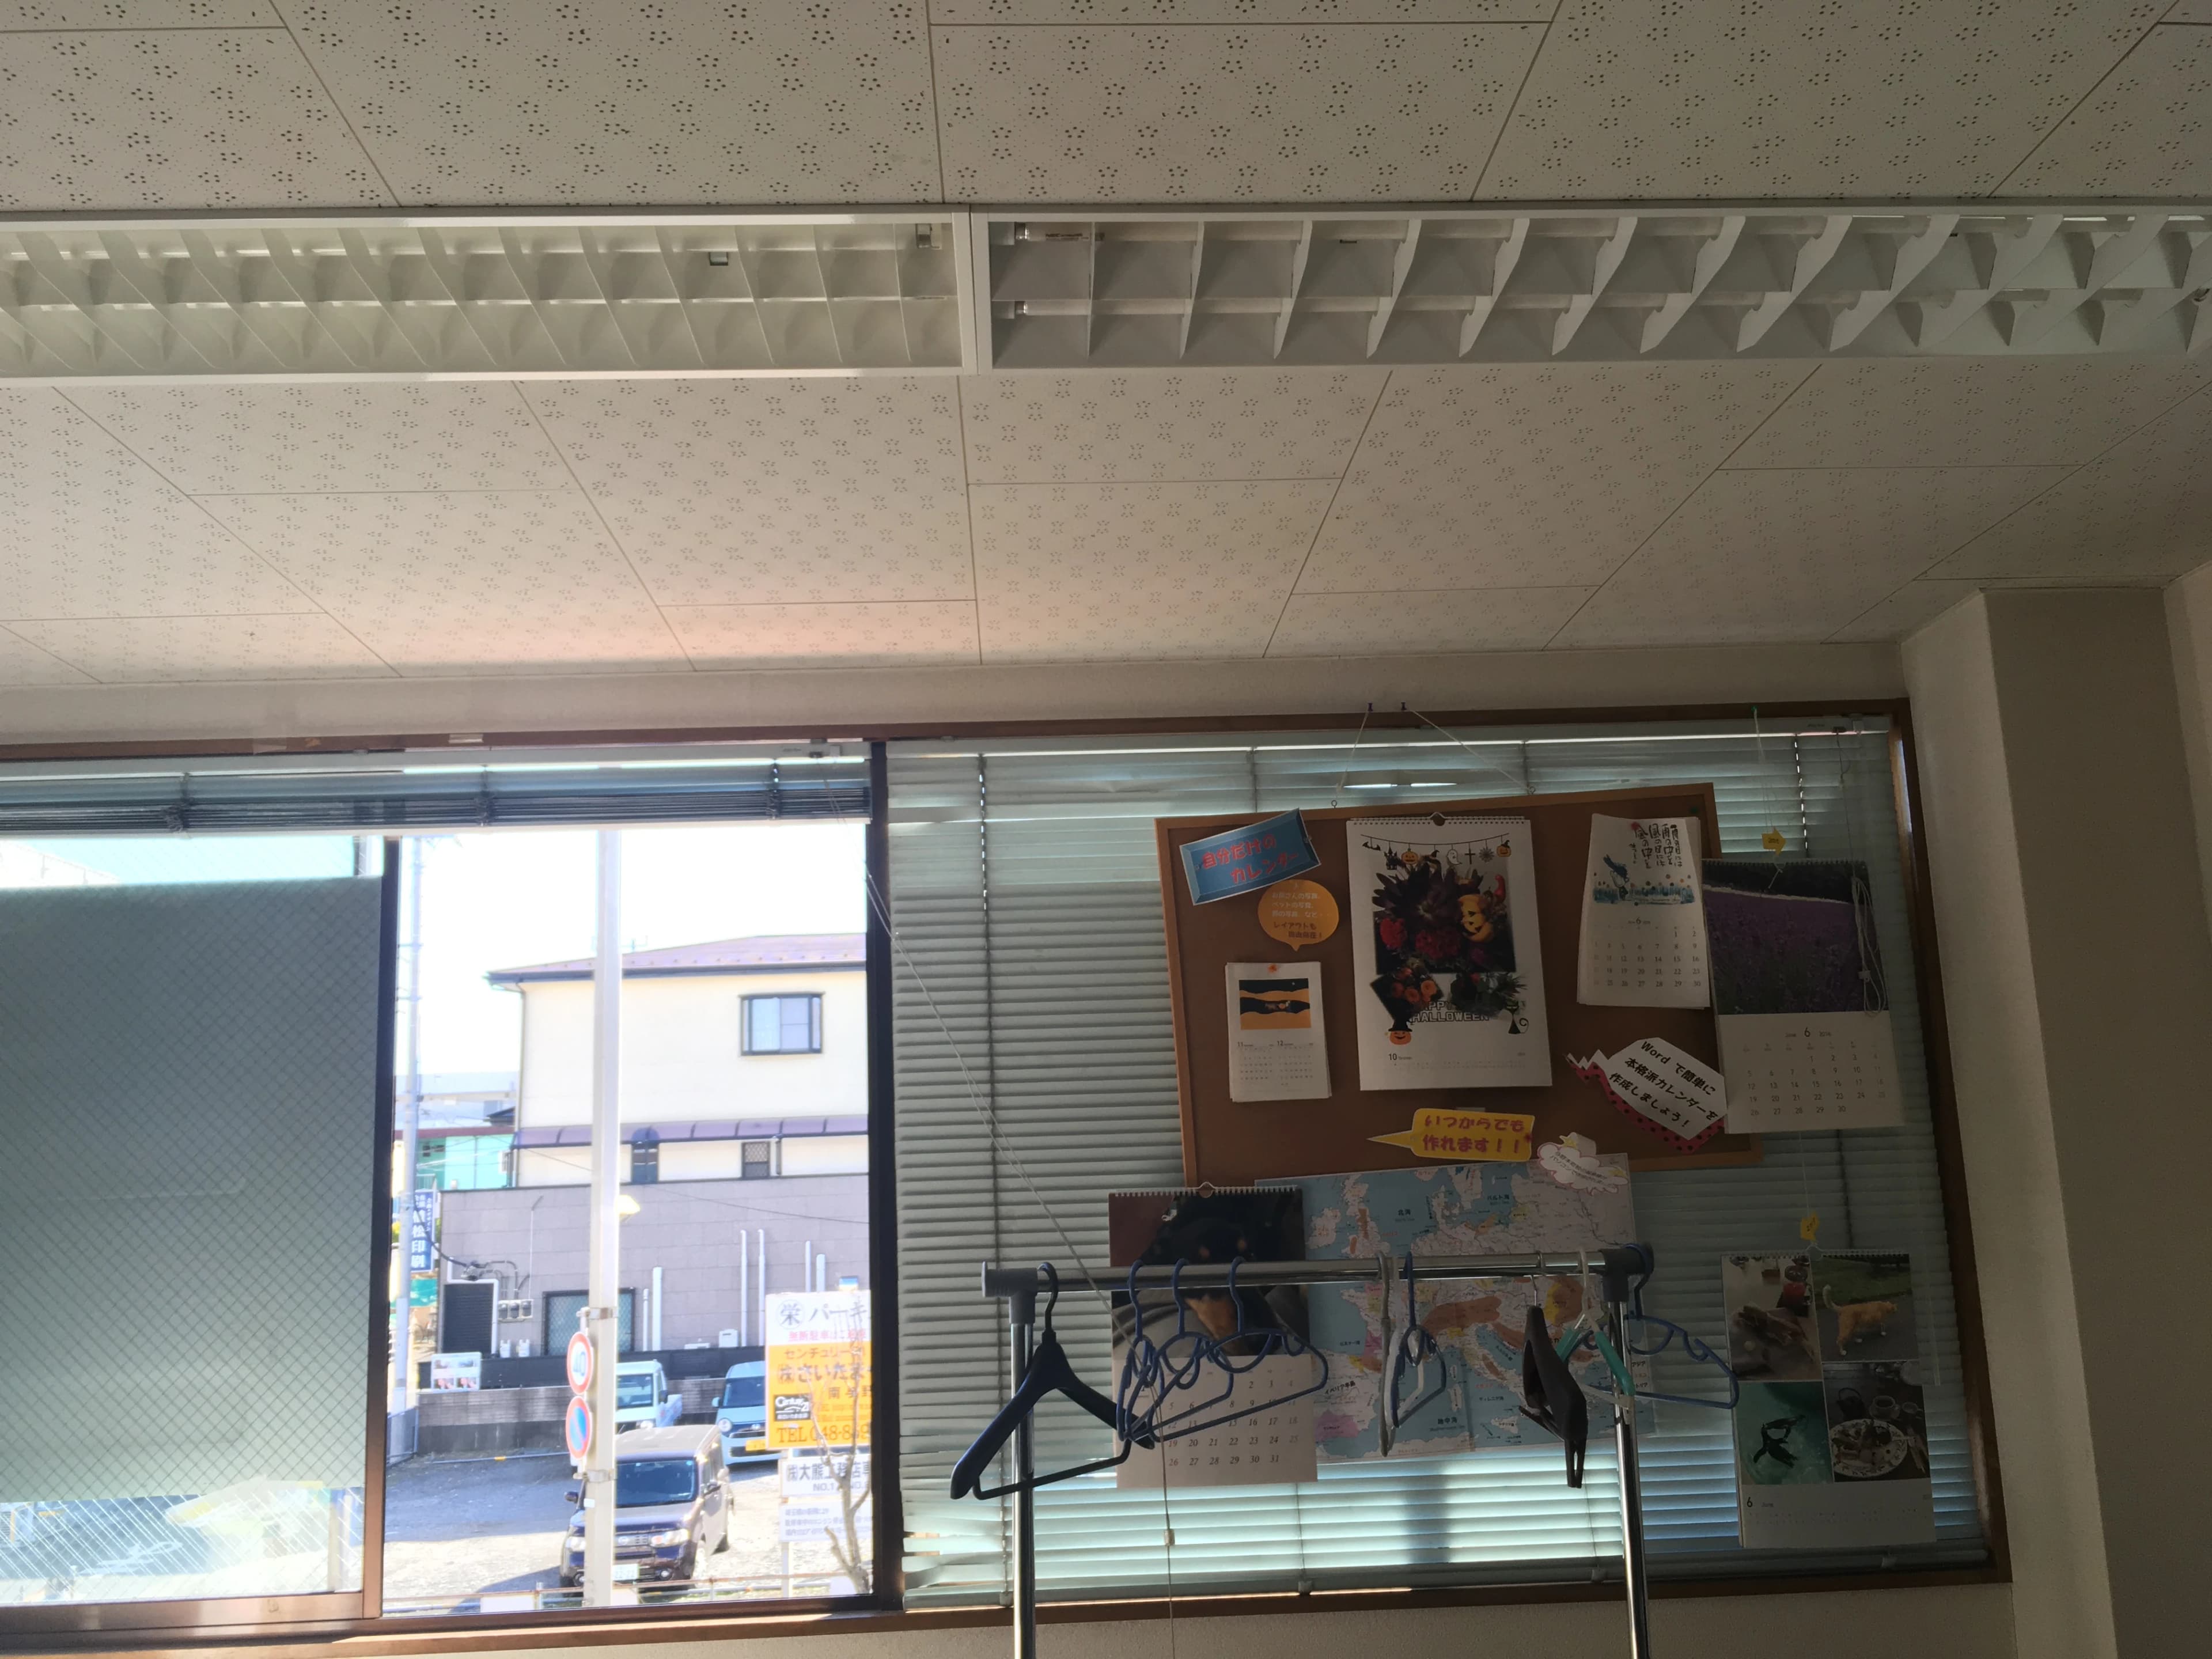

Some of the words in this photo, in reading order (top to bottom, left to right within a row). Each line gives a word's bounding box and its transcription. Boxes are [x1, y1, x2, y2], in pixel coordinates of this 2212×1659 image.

[1203, 834, 1277, 869] 自分だけの
[1231, 851, 1298, 884] カレンダー
[1274, 922, 1317, 930] レイアウトも
[1411, 1011, 1490, 1023] HALLOWEEN
[1804, 1028, 1810, 1037] 6
[1641, 1041, 1672, 1065] Word
[1675, 1062, 1716, 1096] で簡単に
[1625, 1057, 1719, 1120] 本格派カレンダーを
[1609, 1073, 1690, 1127] 作成しましょう！
[1425, 1115, 1524, 1132] いつからでも
[1423, 1134, 1519, 1153] 作れます！！
[1269, 1380, 1274, 1388] 3
[1325, 1381, 1356, 1395] イベリア半島
[1268, 1417, 1278, 1425] 17
[777, 1427, 806, 1443] TEL
[1289, 1435, 1298, 1443] 25
[1747, 1496, 1753, 1508] 6
